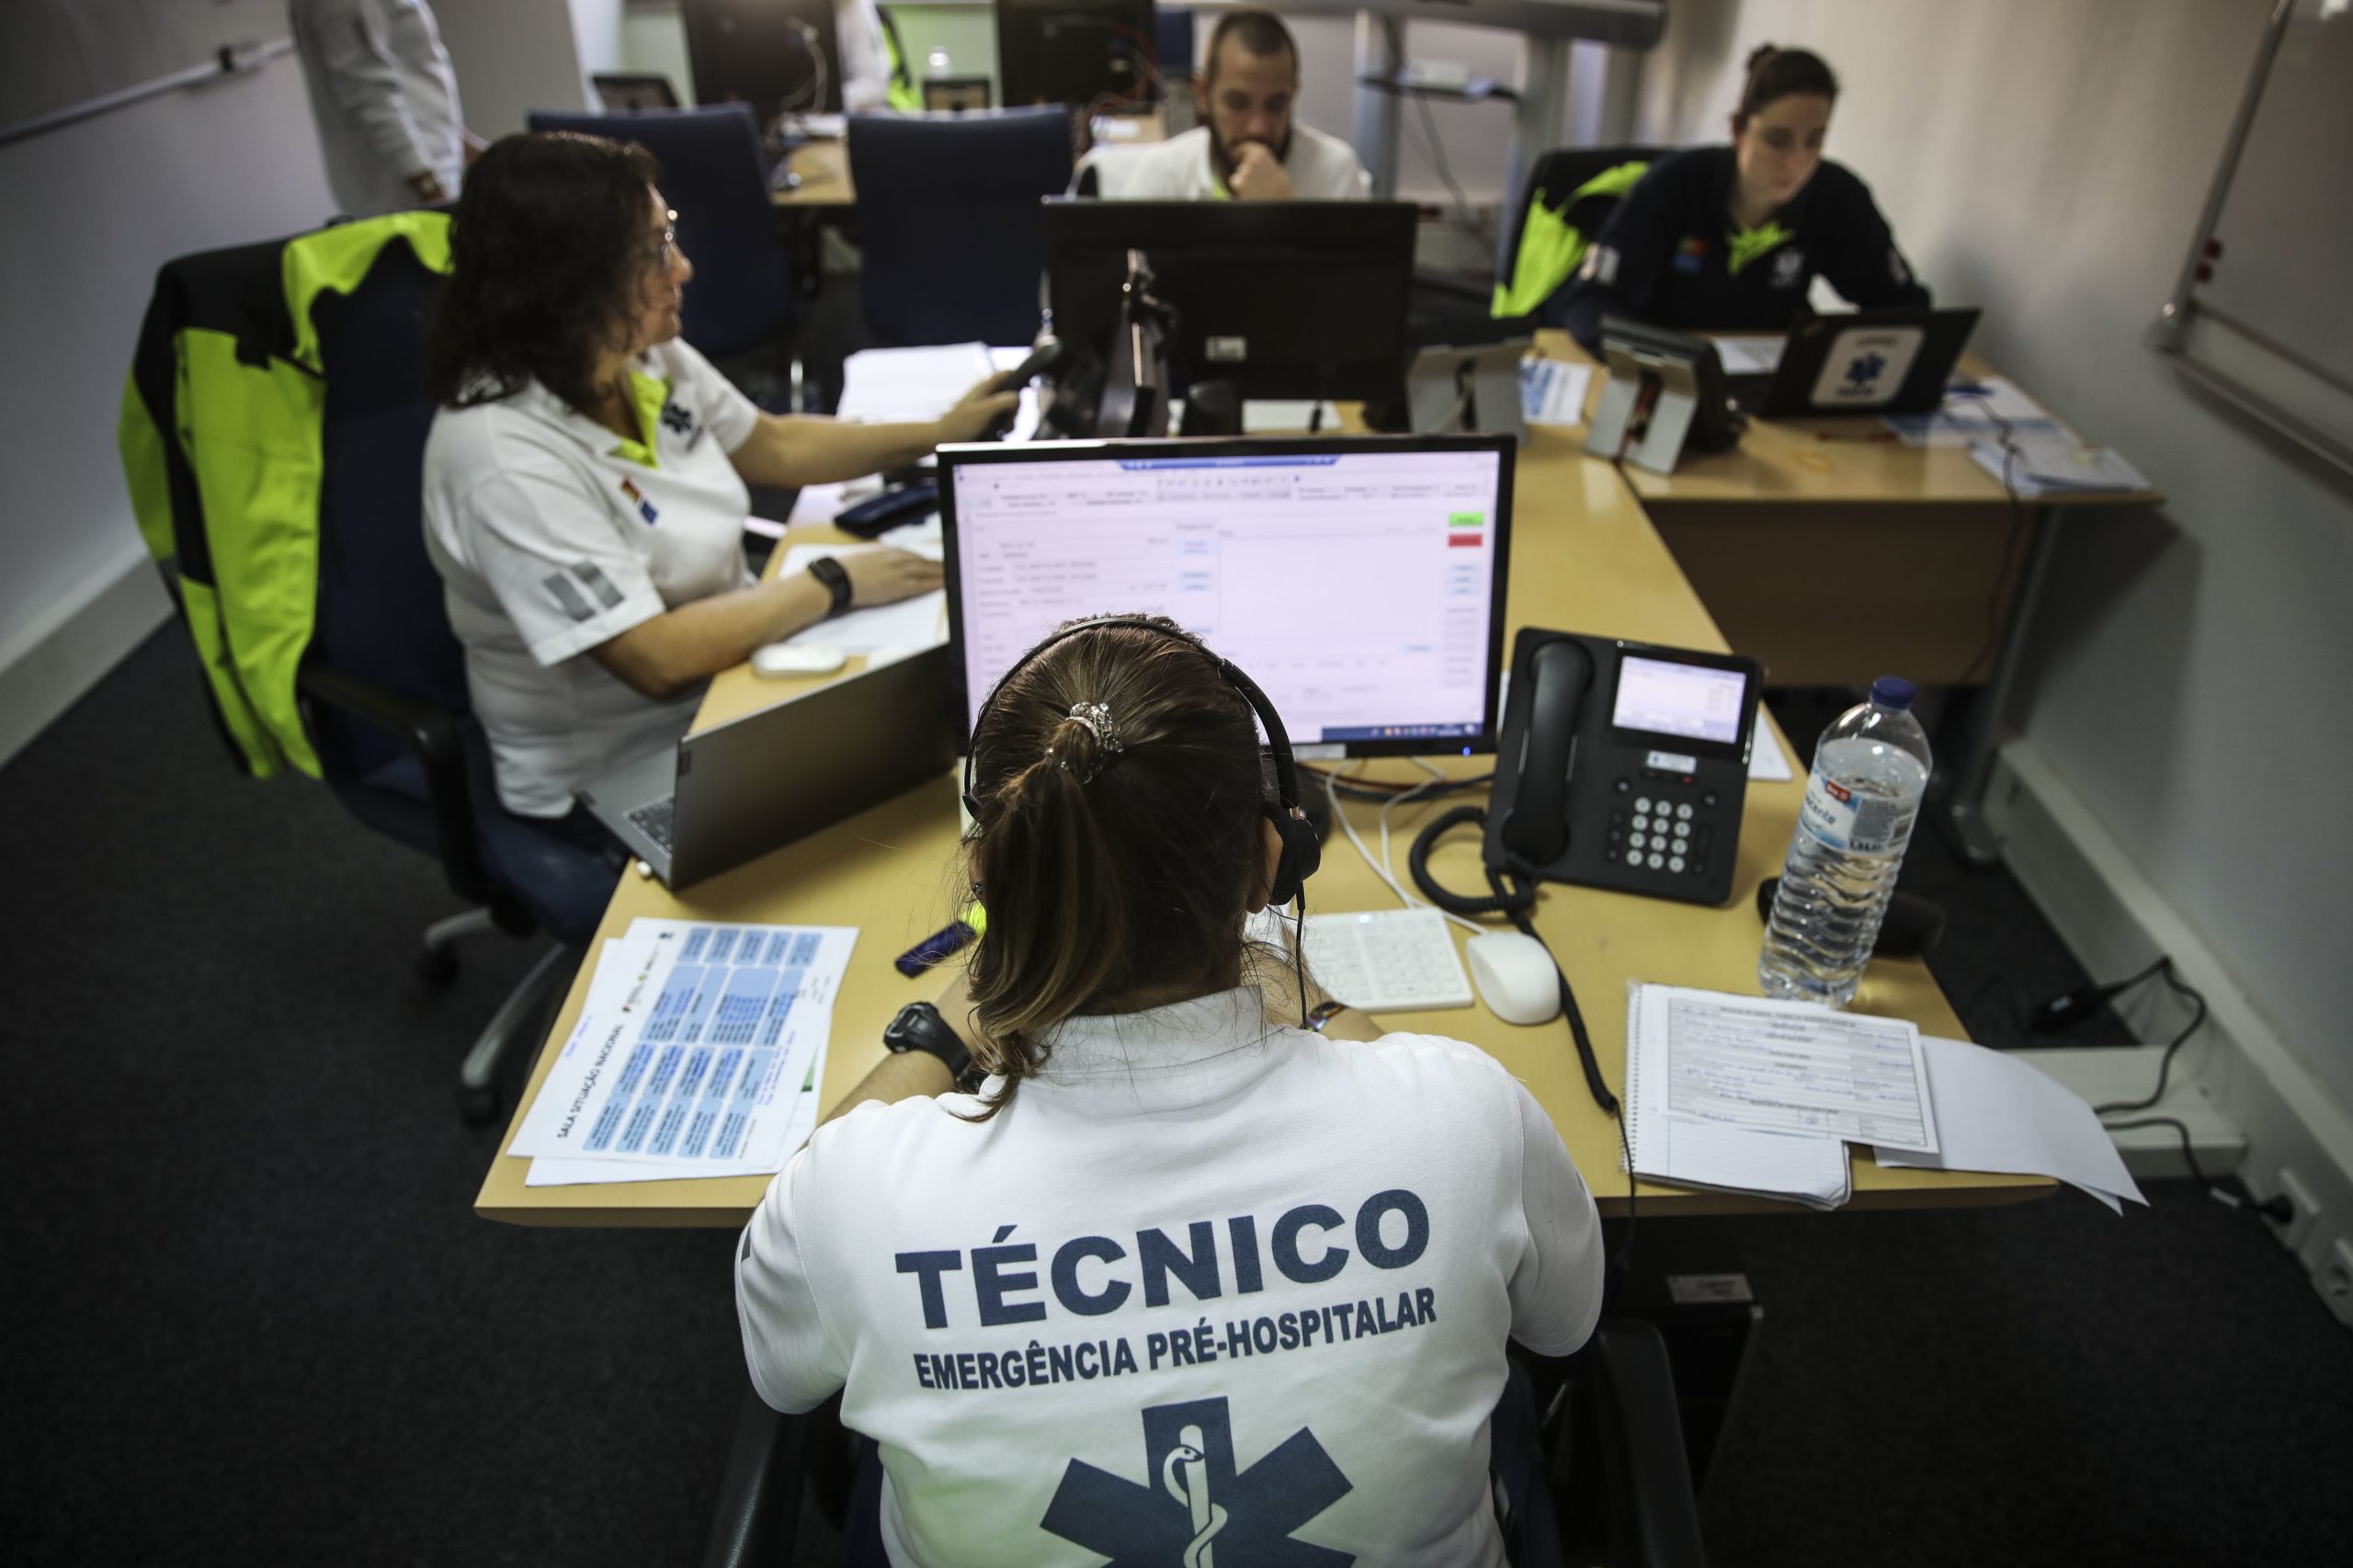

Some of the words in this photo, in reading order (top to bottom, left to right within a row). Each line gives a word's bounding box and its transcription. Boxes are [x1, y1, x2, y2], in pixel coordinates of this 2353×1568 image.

[557, 1115, 576, 1139] SALA
[570, 1067, 601, 1113] SITUAÇÃO
[894, 1188, 1430, 1329] TÉCNICO
[914, 1334, 1139, 1391] EMERGÊNCIA
[1146, 1287, 1438, 1371] PRÉ-HOSPITALAR
